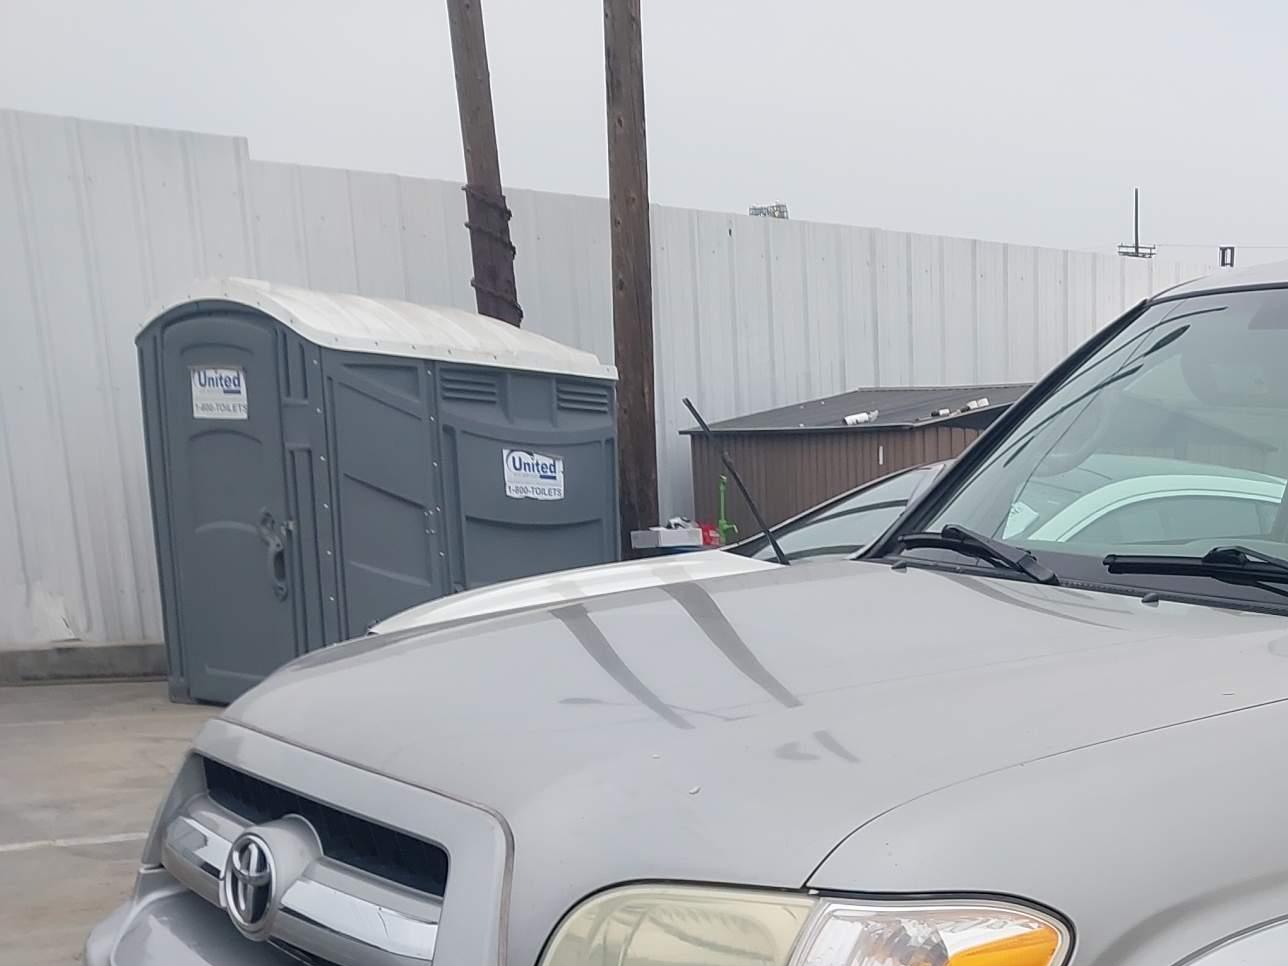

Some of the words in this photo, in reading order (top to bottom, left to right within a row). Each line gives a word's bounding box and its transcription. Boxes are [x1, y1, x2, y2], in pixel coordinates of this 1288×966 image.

[198, 369, 241, 388] United
[512, 455, 556, 474] United
[508, 485, 562, 497] 1-800-TOILETS
